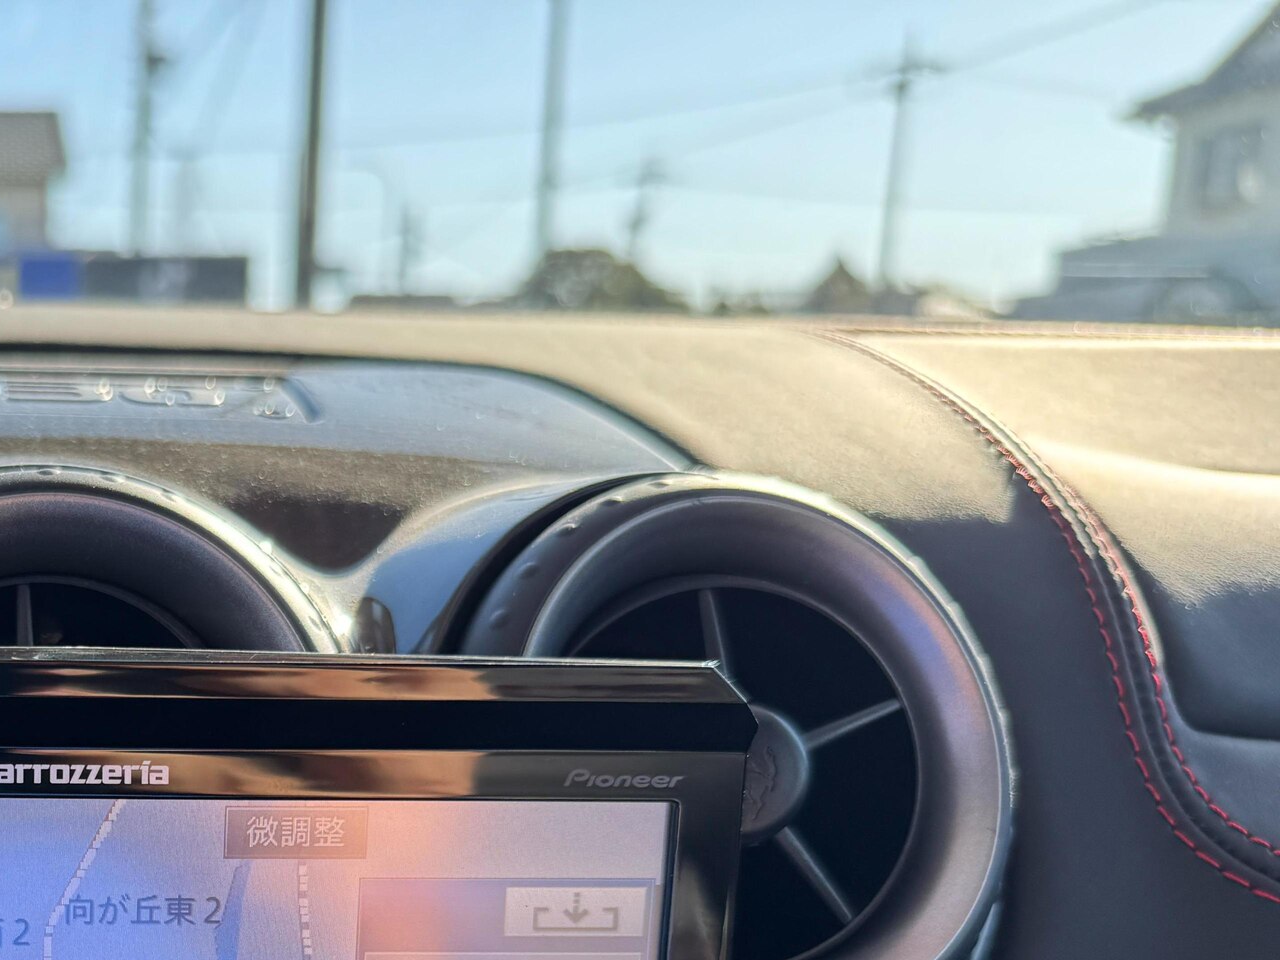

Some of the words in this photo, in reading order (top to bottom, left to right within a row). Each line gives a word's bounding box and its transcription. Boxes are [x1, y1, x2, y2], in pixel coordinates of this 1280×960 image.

[564, 768, 685, 789] Pioneer
[246, 815, 346, 848] 微調整
